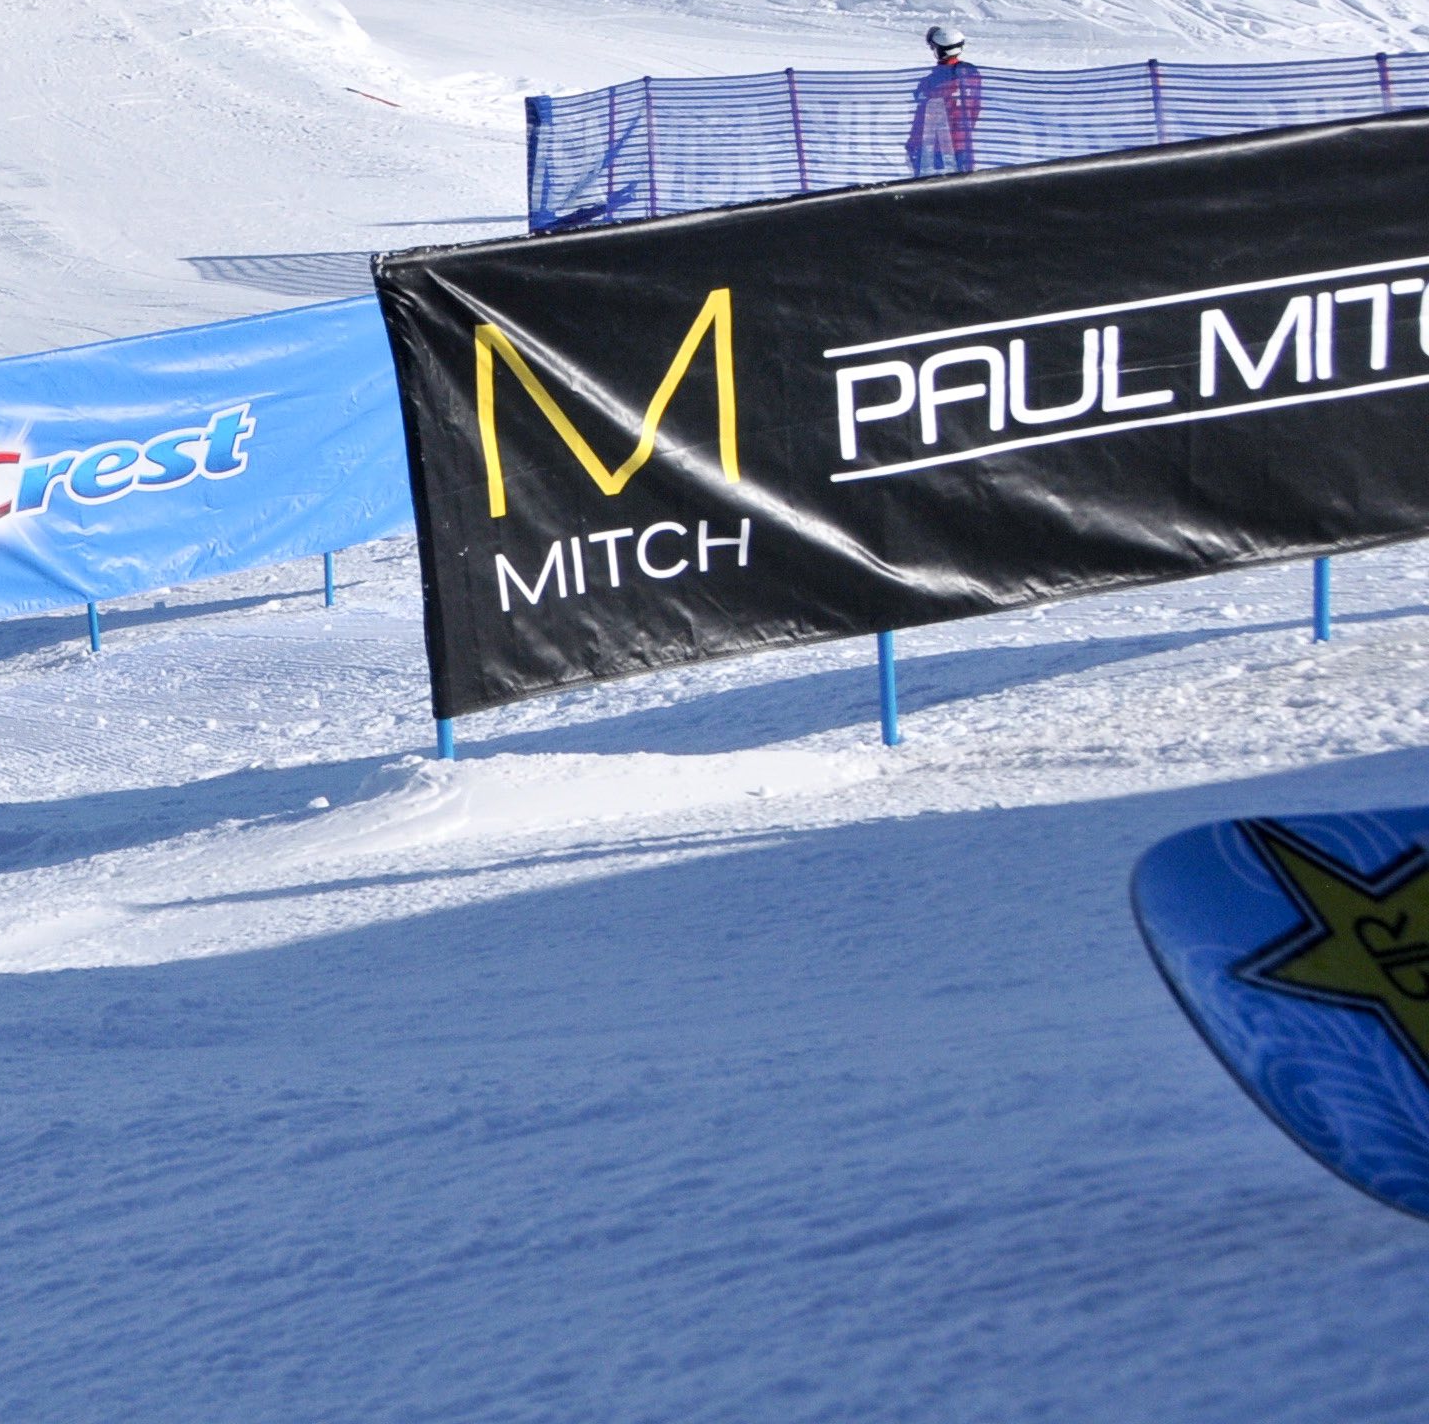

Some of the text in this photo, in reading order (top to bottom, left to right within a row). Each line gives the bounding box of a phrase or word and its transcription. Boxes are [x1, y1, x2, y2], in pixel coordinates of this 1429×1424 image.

[836, 279, 1429, 461] PAUL MIT
[494, 517, 751, 613] MITCH
